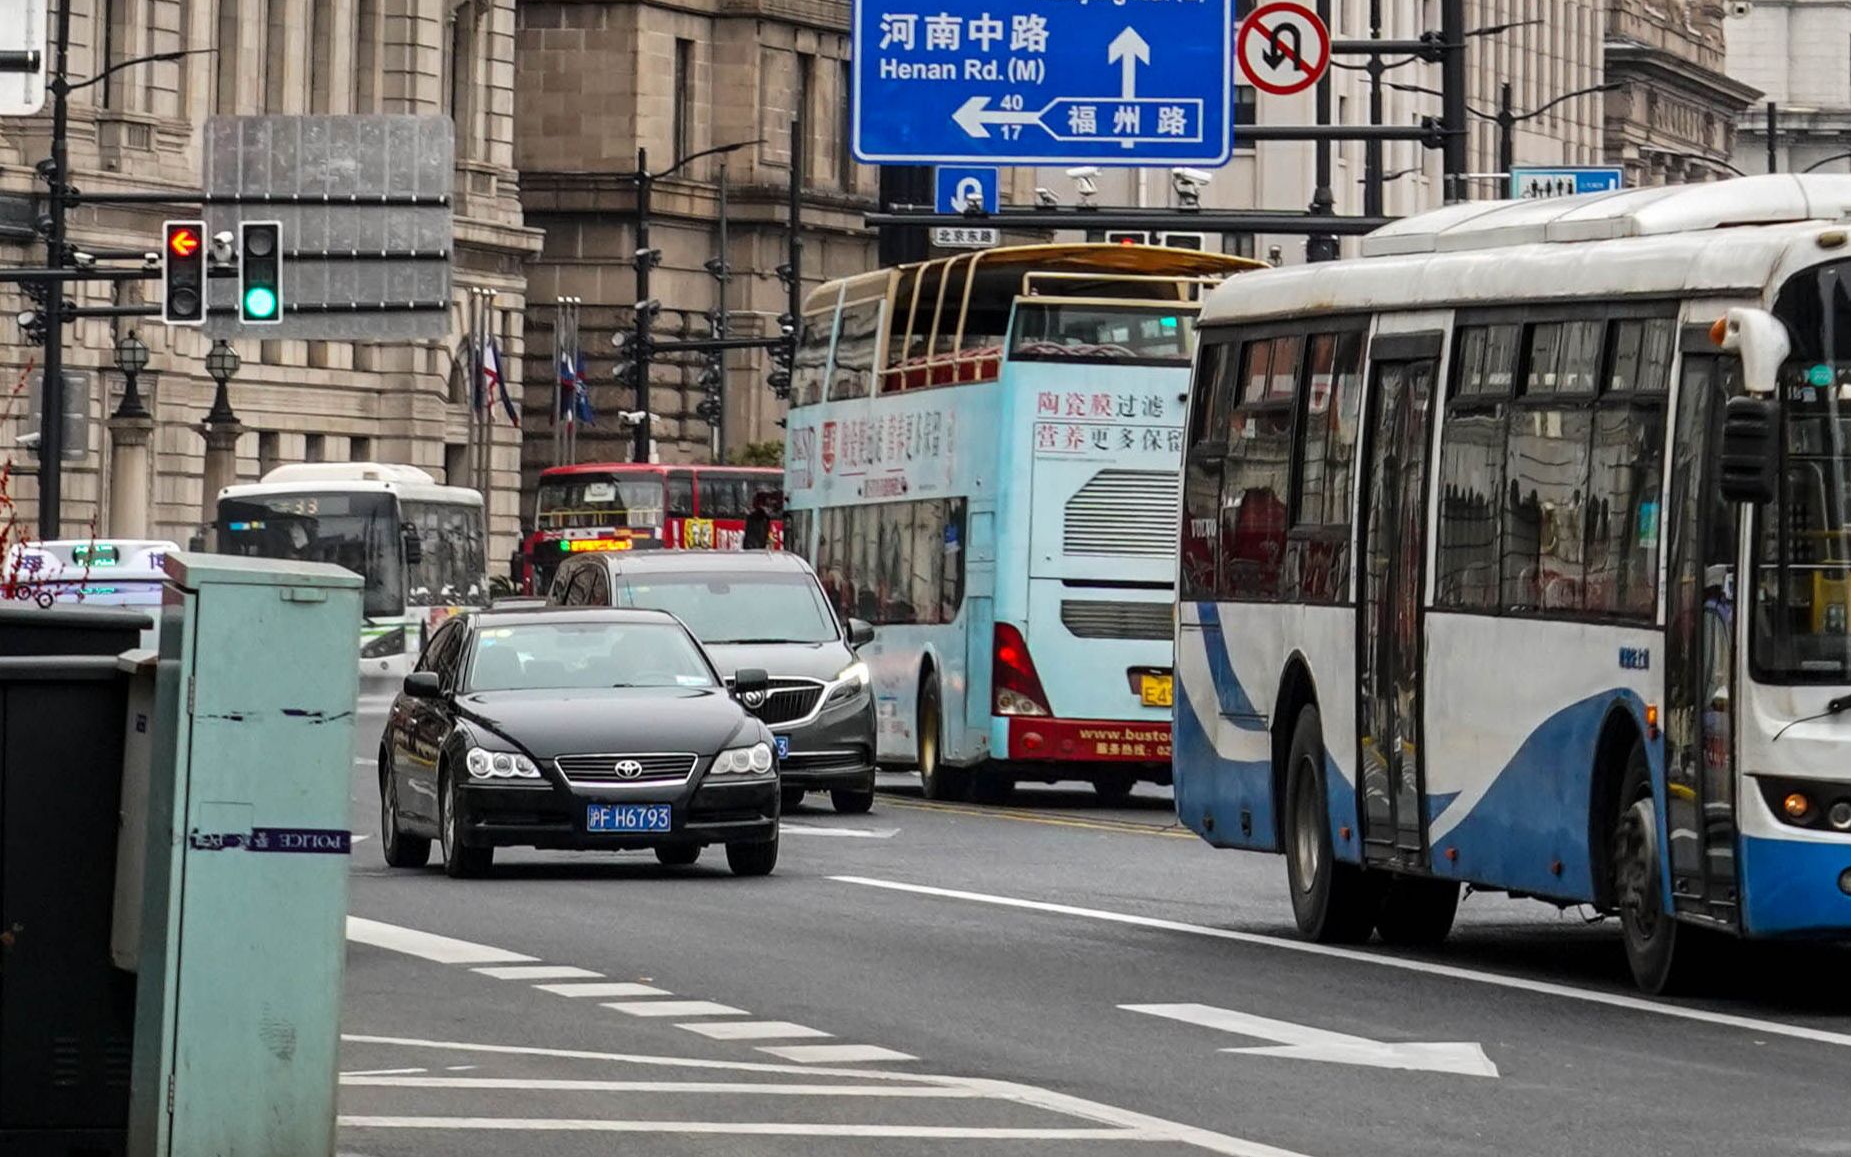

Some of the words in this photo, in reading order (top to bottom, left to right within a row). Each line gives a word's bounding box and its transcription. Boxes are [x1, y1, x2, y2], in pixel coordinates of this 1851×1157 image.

[879, 11, 1049, 54] 河南中路
[879, 58, 957, 80] Henan
[963, 59, 1004, 81] Rd.
[1007, 57, 1046, 85] (M)
[1000, 94, 1024, 111] 40
[1067, 105, 1188, 136] 福州路
[1000, 124, 1023, 141] 17
[939, 228, 993, 243] 北京东路
[281, 833, 342, 849] POLICE
